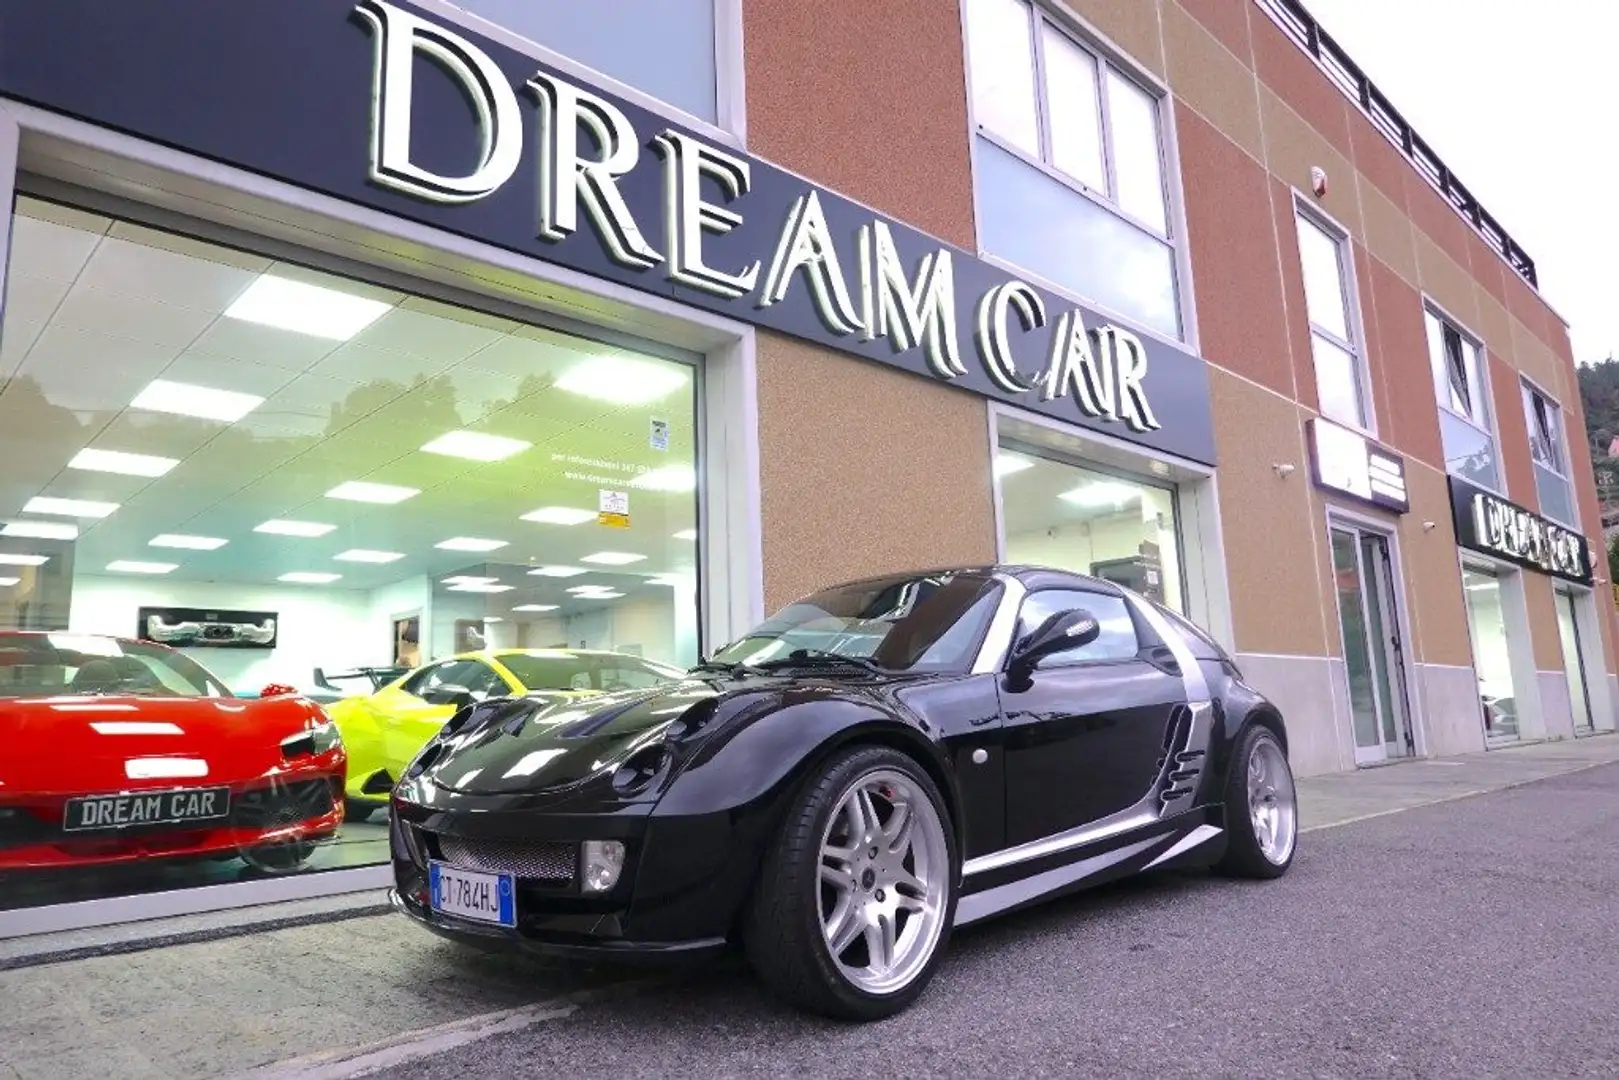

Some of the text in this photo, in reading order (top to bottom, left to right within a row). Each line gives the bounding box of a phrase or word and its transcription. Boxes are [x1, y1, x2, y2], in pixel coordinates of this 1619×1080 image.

[356, 0, 1161, 433] DREAM CAR
[81, 792, 215, 826] DREAM CAR
